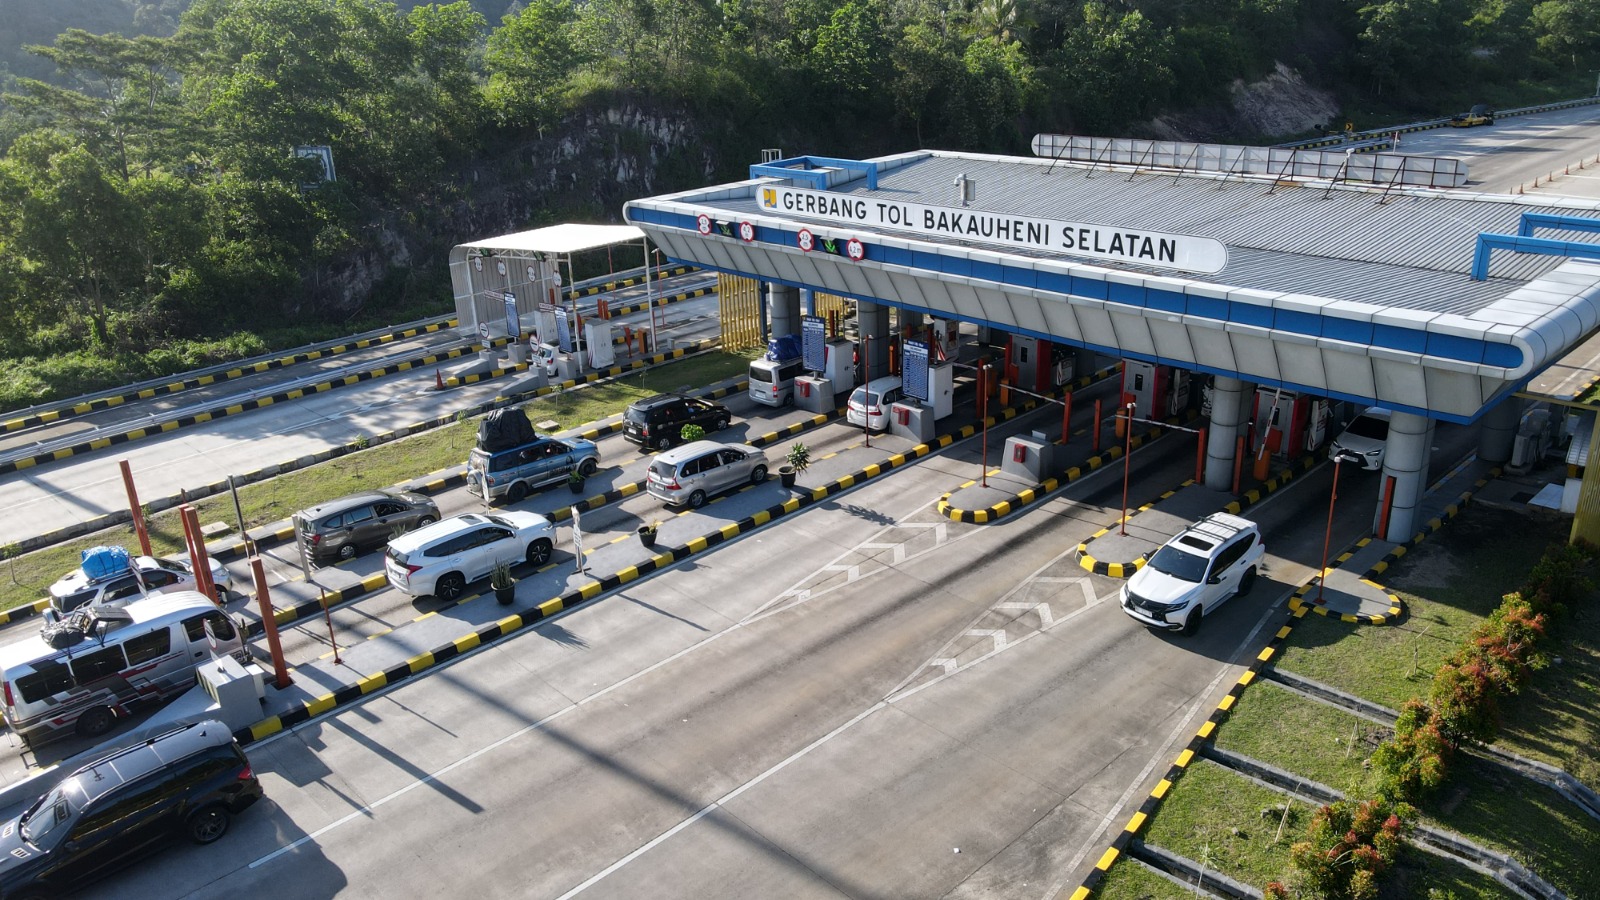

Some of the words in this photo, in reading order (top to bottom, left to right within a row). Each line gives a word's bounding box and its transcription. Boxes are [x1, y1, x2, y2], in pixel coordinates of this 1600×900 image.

[783, 191, 867, 220] GERBANG
[876, 203, 913, 227] TOL
[923, 209, 1050, 246] BAKAUHENI
[1062, 226, 1177, 263] SELATAN
